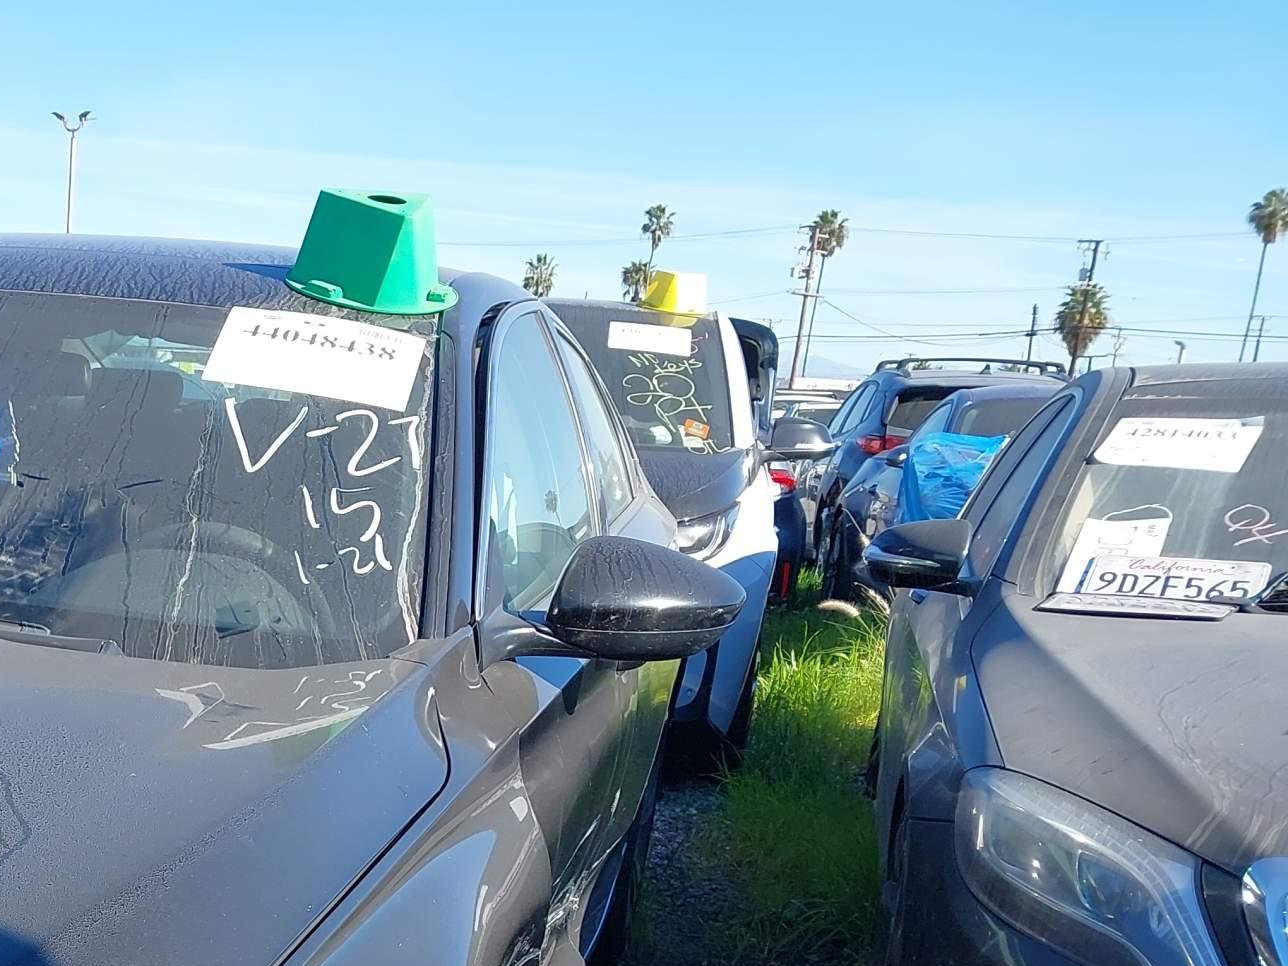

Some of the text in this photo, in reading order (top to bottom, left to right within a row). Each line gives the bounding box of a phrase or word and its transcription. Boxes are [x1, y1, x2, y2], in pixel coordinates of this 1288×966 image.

[242, 323, 397, 362] 44048438
[300, 484, 382, 543] 15
[293, 533, 393, 585] 1-21
[1128, 558, 1226, 576] California
[1093, 571, 1252, 601] 9DZF565
